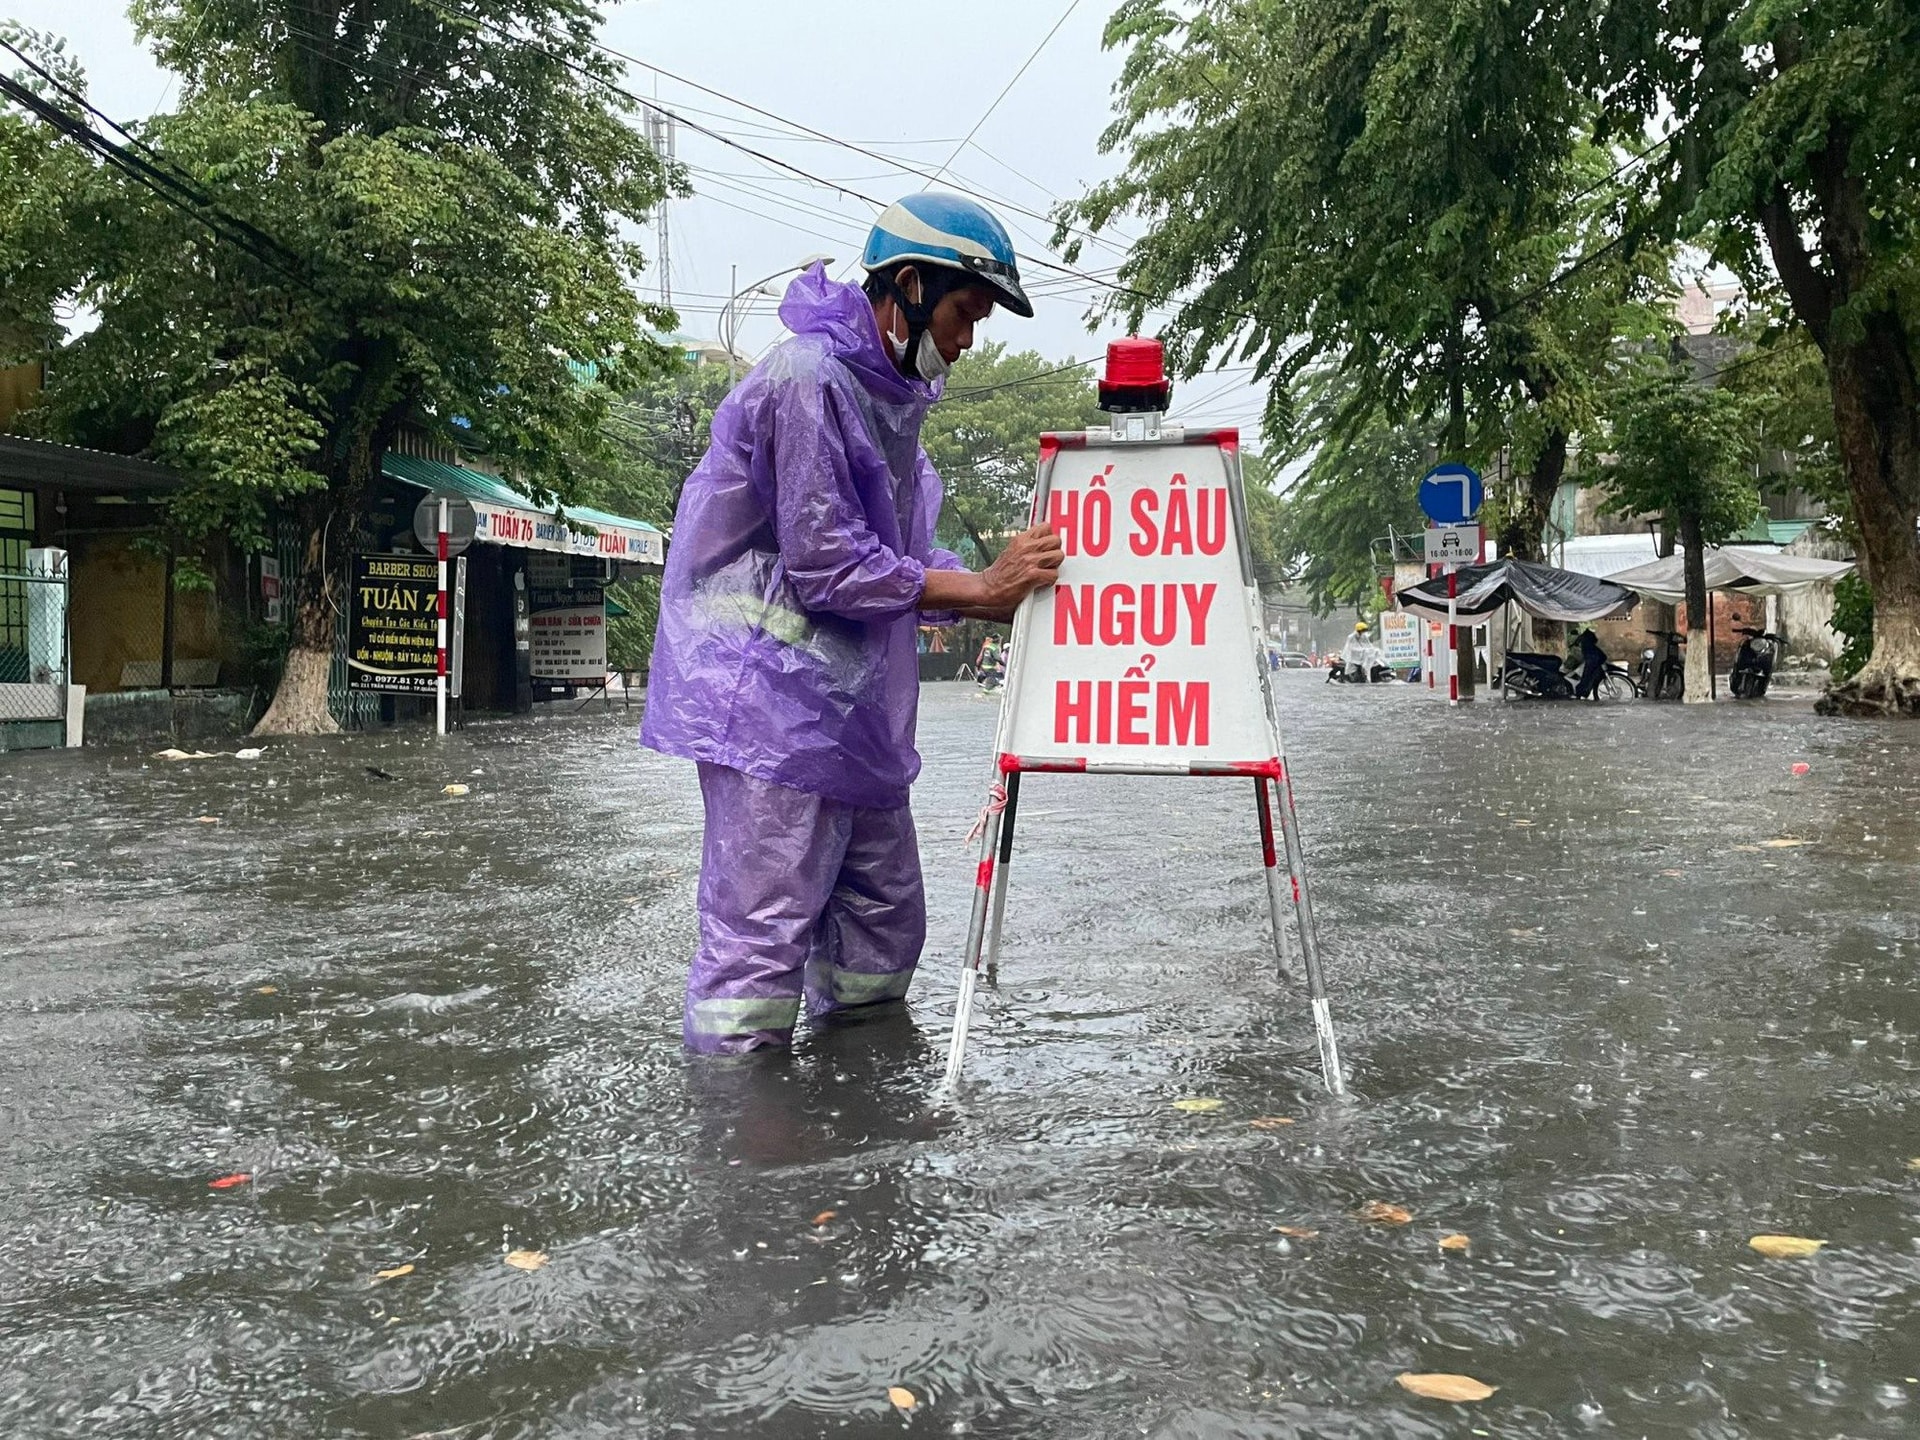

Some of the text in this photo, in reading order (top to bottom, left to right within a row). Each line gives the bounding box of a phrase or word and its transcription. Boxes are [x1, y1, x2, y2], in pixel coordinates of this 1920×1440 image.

[521, 519, 533, 541] 76
[1050, 464, 1227, 558] HỐ SÂU
[368, 561, 411, 577] BARBER
[359, 582, 439, 612] TUẤN 7
[1053, 583, 1218, 646] NGUY
[1054, 654, 1210, 746] HIỂM
